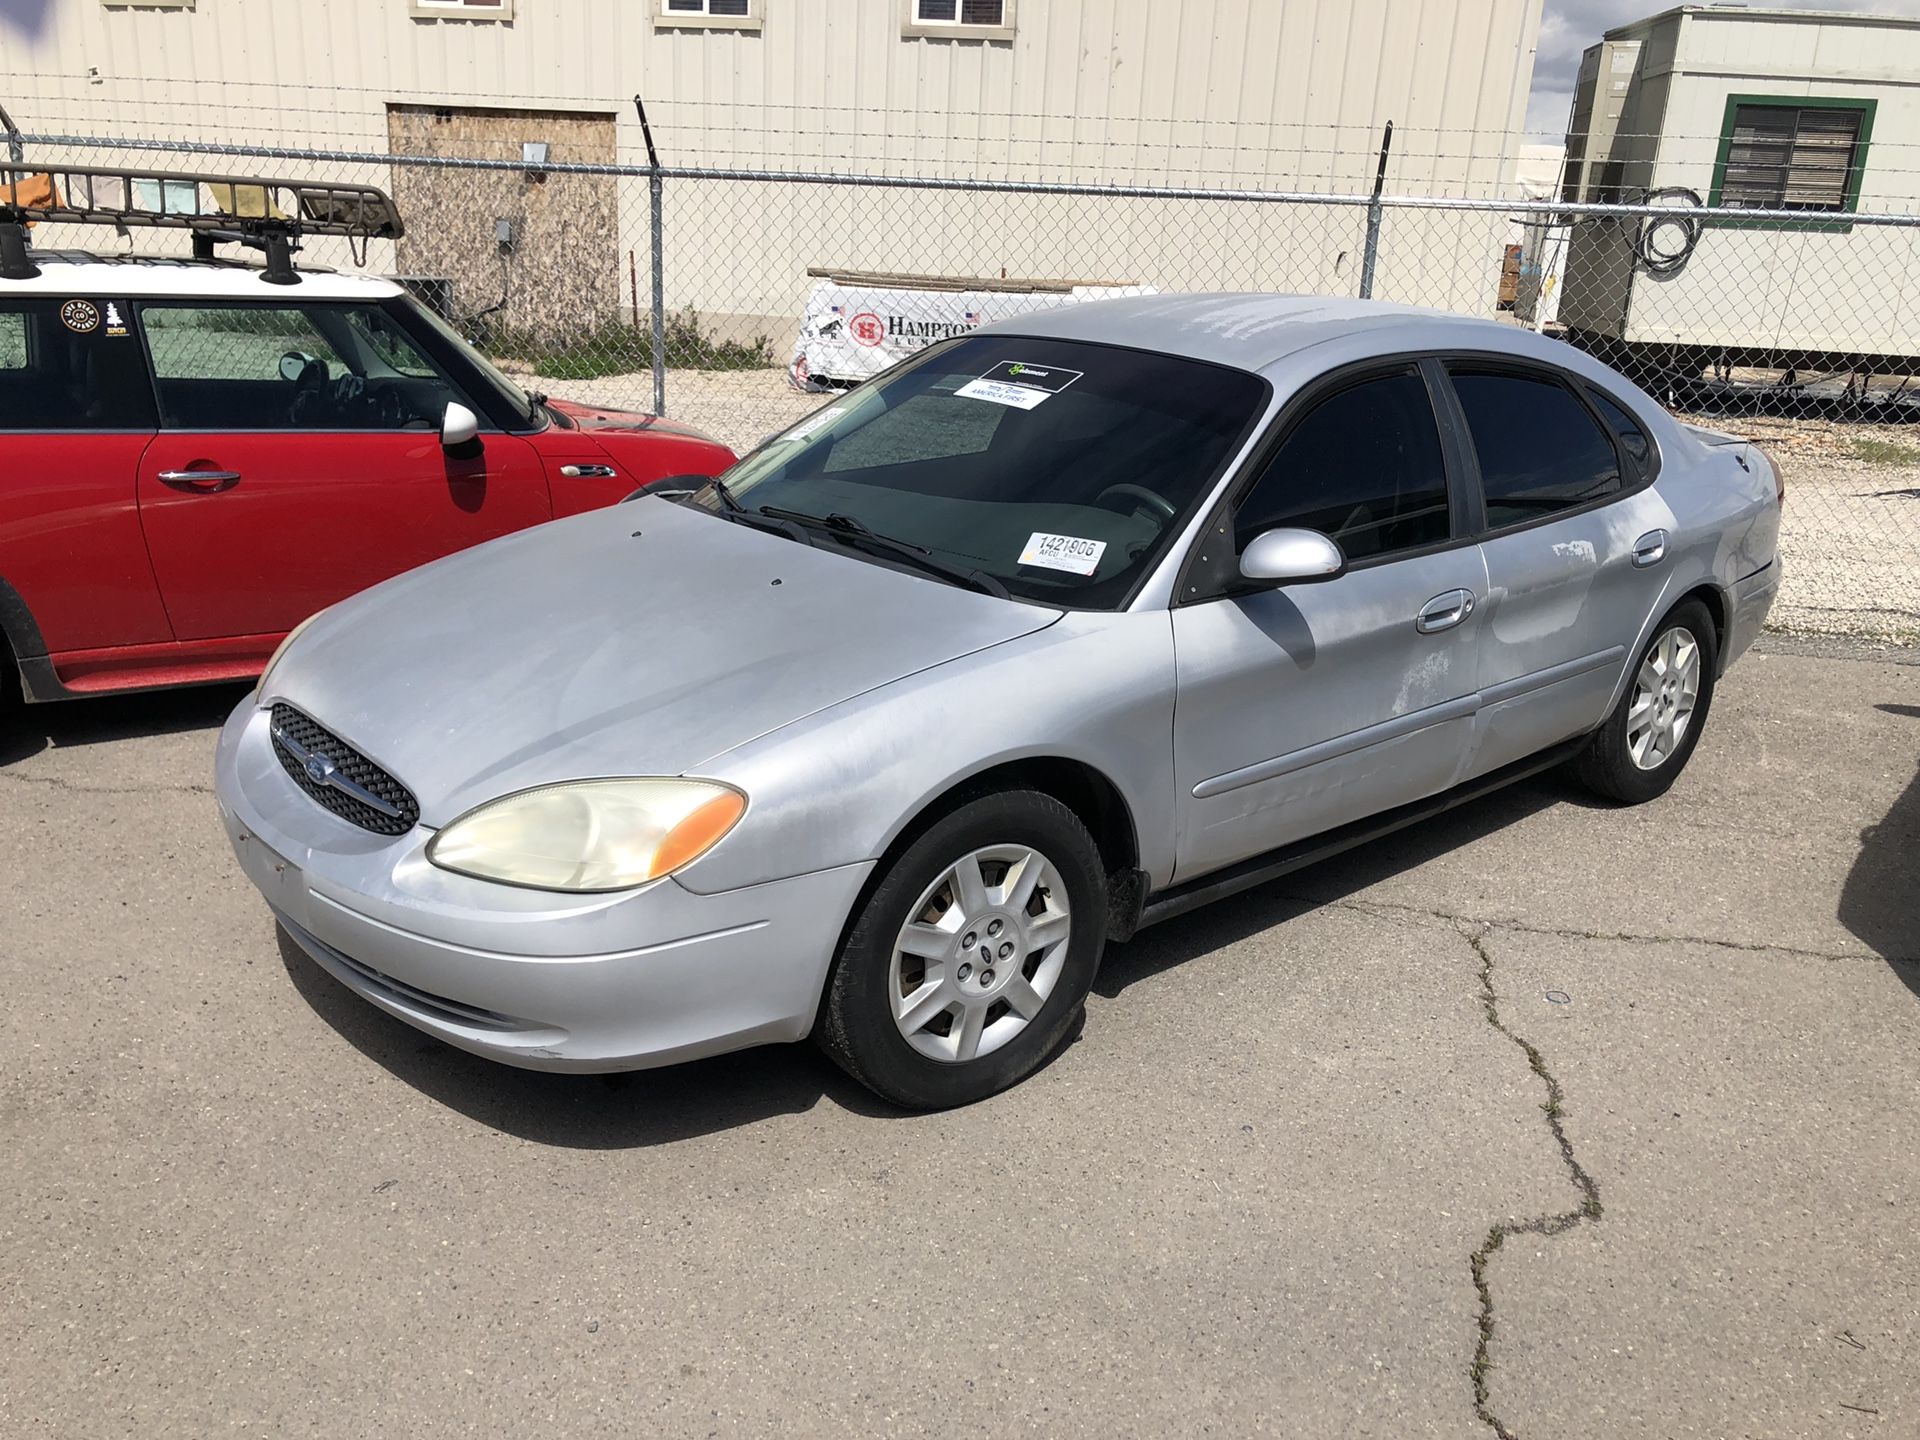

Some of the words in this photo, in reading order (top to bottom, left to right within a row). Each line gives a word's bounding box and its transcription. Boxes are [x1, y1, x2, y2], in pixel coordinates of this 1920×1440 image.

[65, 303, 75, 316] LIVE
[77, 302, 94, 315] DEAD
[895, 337, 941, 346] LUM
[971, 388, 1003, 398] AMERICA
[1001, 393, 1028, 403] FIRST
[1039, 536, 1097, 557] 1421906
